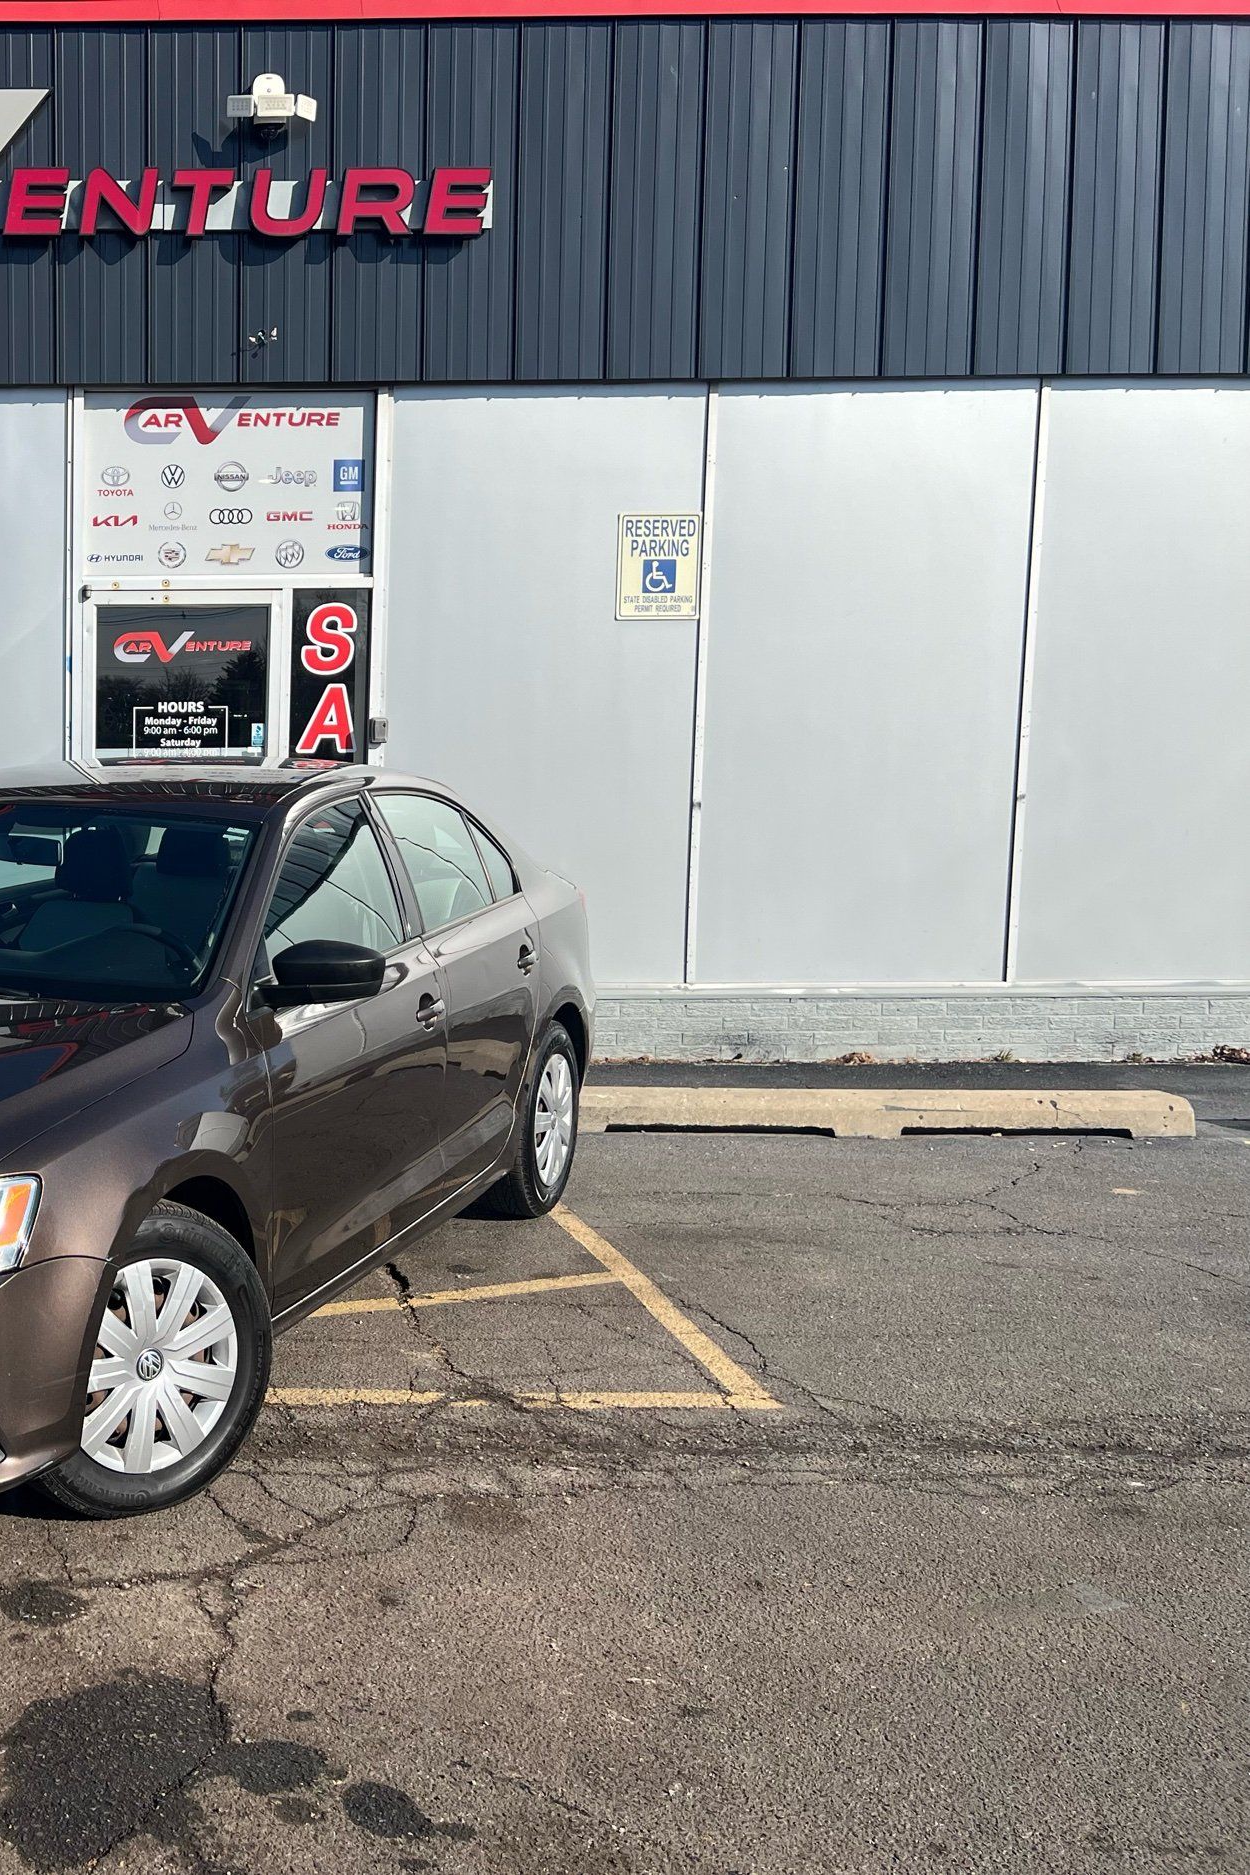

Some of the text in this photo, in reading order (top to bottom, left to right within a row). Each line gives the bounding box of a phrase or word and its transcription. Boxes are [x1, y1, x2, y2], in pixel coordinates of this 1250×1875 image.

[268, 467, 317, 487] Jeep
[340, 466, 358, 481] GM
[97, 489, 134, 497] TOYOTA
[92, 515, 138, 527] KIA
[266, 511, 313, 522] GMC
[148, 524, 198, 532] Mercedes-Benz
[625, 519, 696, 538] RESERVED
[333, 547, 361, 560] Ford
[630, 539, 690, 557] PARKING
[104, 554, 144, 562] HYUNDAI
[623, 596, 693, 604] STATE DISABLED PARKING
[634, 604, 653, 613] PERMIT
[655, 604, 681, 613] REQUIRED
[157, 701, 205, 713] HOURS
[144, 716, 182, 727] Monday
[188, 716, 218, 727] Friday
[143, 727, 162, 735] 9:00
[183, 726, 202, 735] 6:00
[203, 727, 218, 736] pm
[160, 737, 202, 748] Saturday
